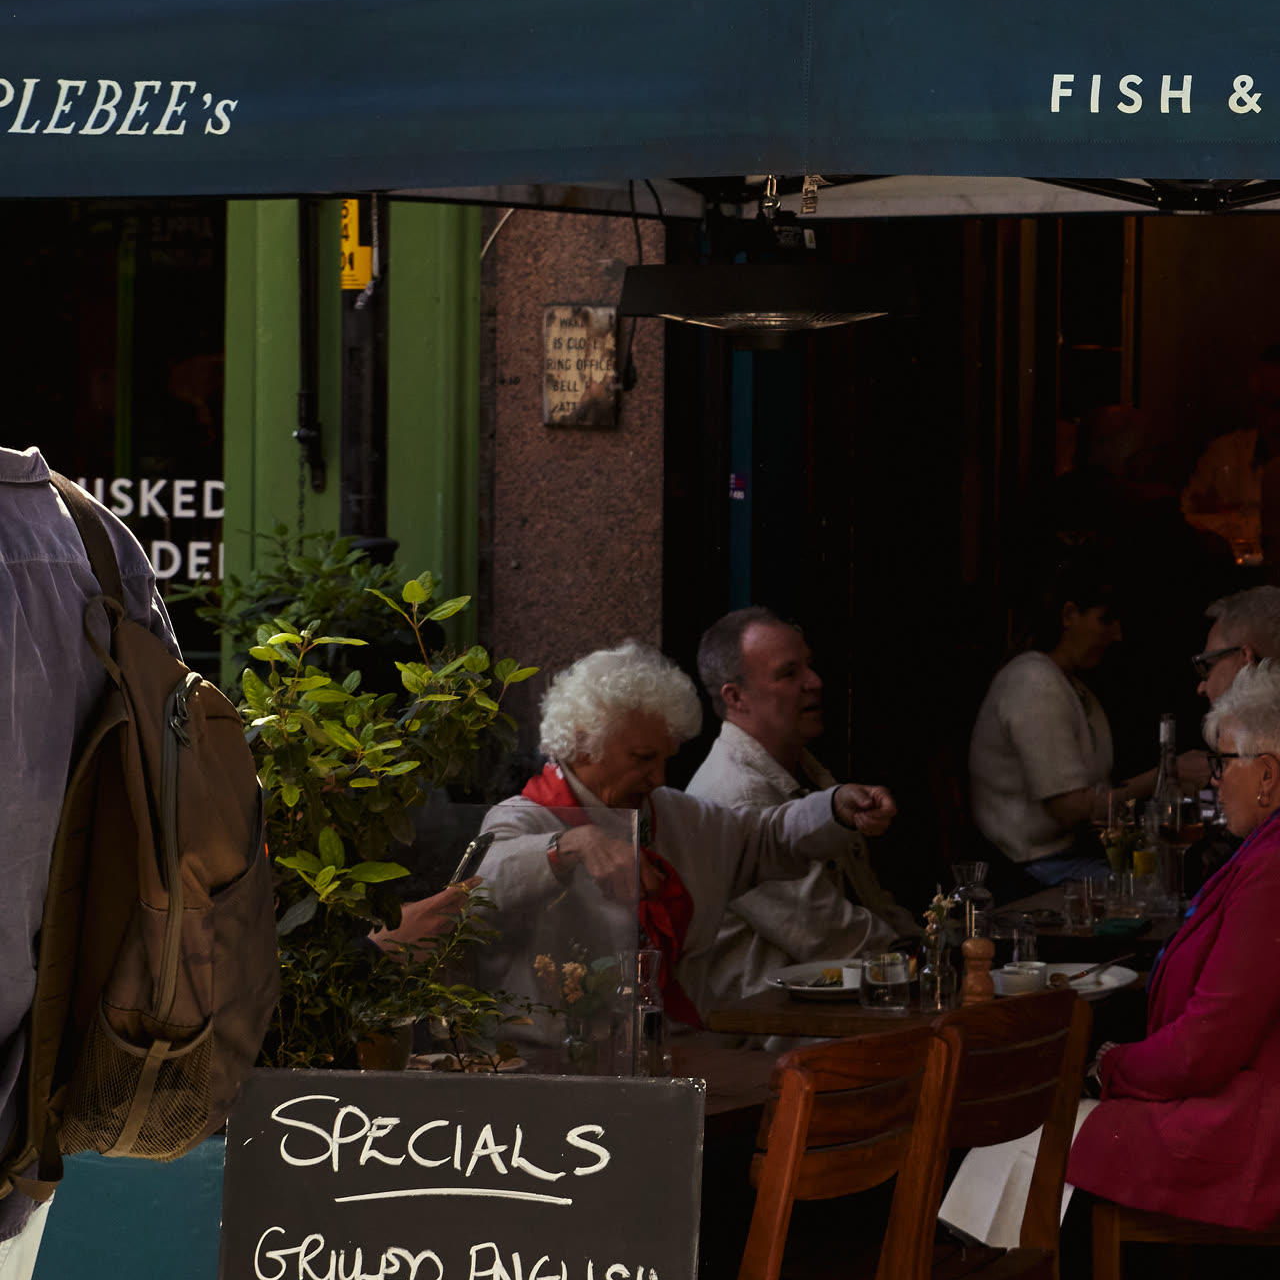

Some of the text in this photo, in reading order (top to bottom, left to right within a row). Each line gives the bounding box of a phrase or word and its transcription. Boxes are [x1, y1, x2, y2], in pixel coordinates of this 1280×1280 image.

[1050, 73, 1193, 114] FISH
[1228, 74, 1262, 114] &
[271, 1094, 611, 1182] SPECIALS
